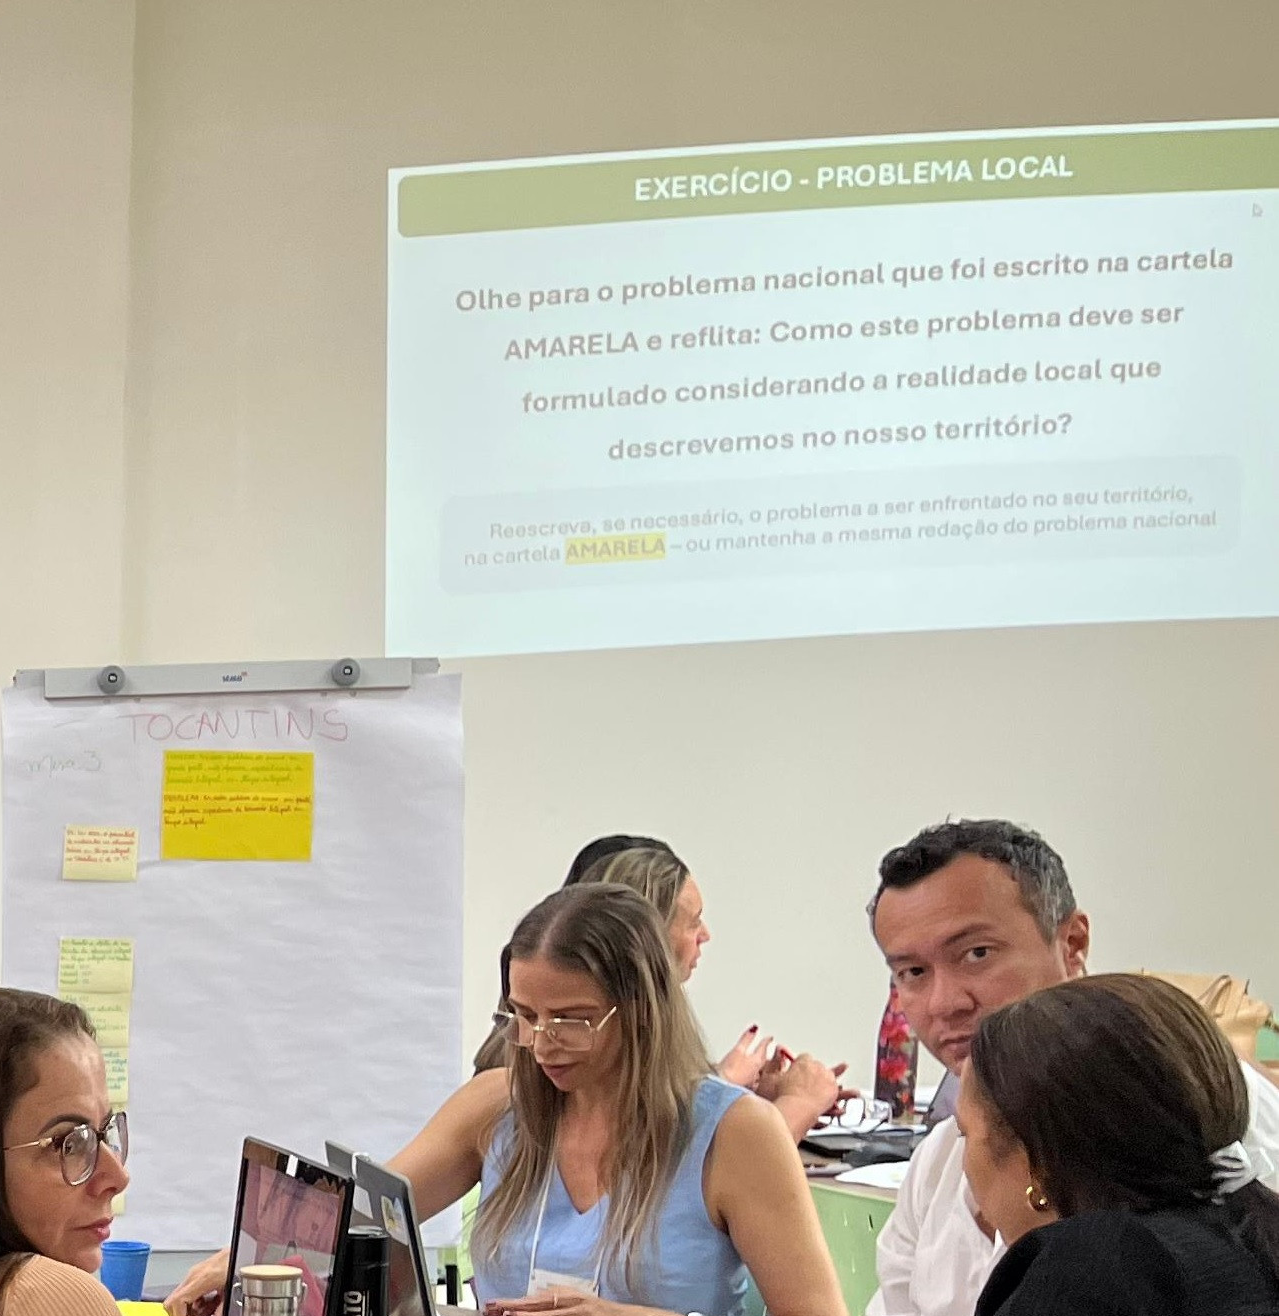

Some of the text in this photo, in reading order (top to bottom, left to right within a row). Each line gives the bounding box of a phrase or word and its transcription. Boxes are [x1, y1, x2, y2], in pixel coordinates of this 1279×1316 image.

[633, 165, 793, 203] EXERCÍCIO
[816, 160, 973, 190] PROBLEMA
[981, 155, 1074, 181] LOCAL
[456, 246, 1234, 312] Olhe para o problema nacional que foi escrito na cartela
[504, 304, 1185, 362] AMARELA e reflita: Como este problema deve ser
[522, 357, 1162, 414] formulado considerando a realidade local que
[608, 412, 1073, 461] descrevemos no nosso território?
[463, 551, 488, 567] na
[493, 544, 560, 565] cartela
[565, 537, 666, 562] AMARELA
[685, 538, 711, 553] ou
[716, 530, 817, 552] mantenha
[821, 530, 834, 544] a
[838, 525, 912, 543] mesma
[917, 517, 999, 540] redação
[1003, 517, 1029, 535] do
[1033, 514, 1128, 537] problema
[1133, 509, 1217, 529] nacional
[489, 483, 1194, 541] Reescreva, se necessário, o problema a ser enfrentado no seu território,
[117, 706, 348, 744] TOCANTINS
